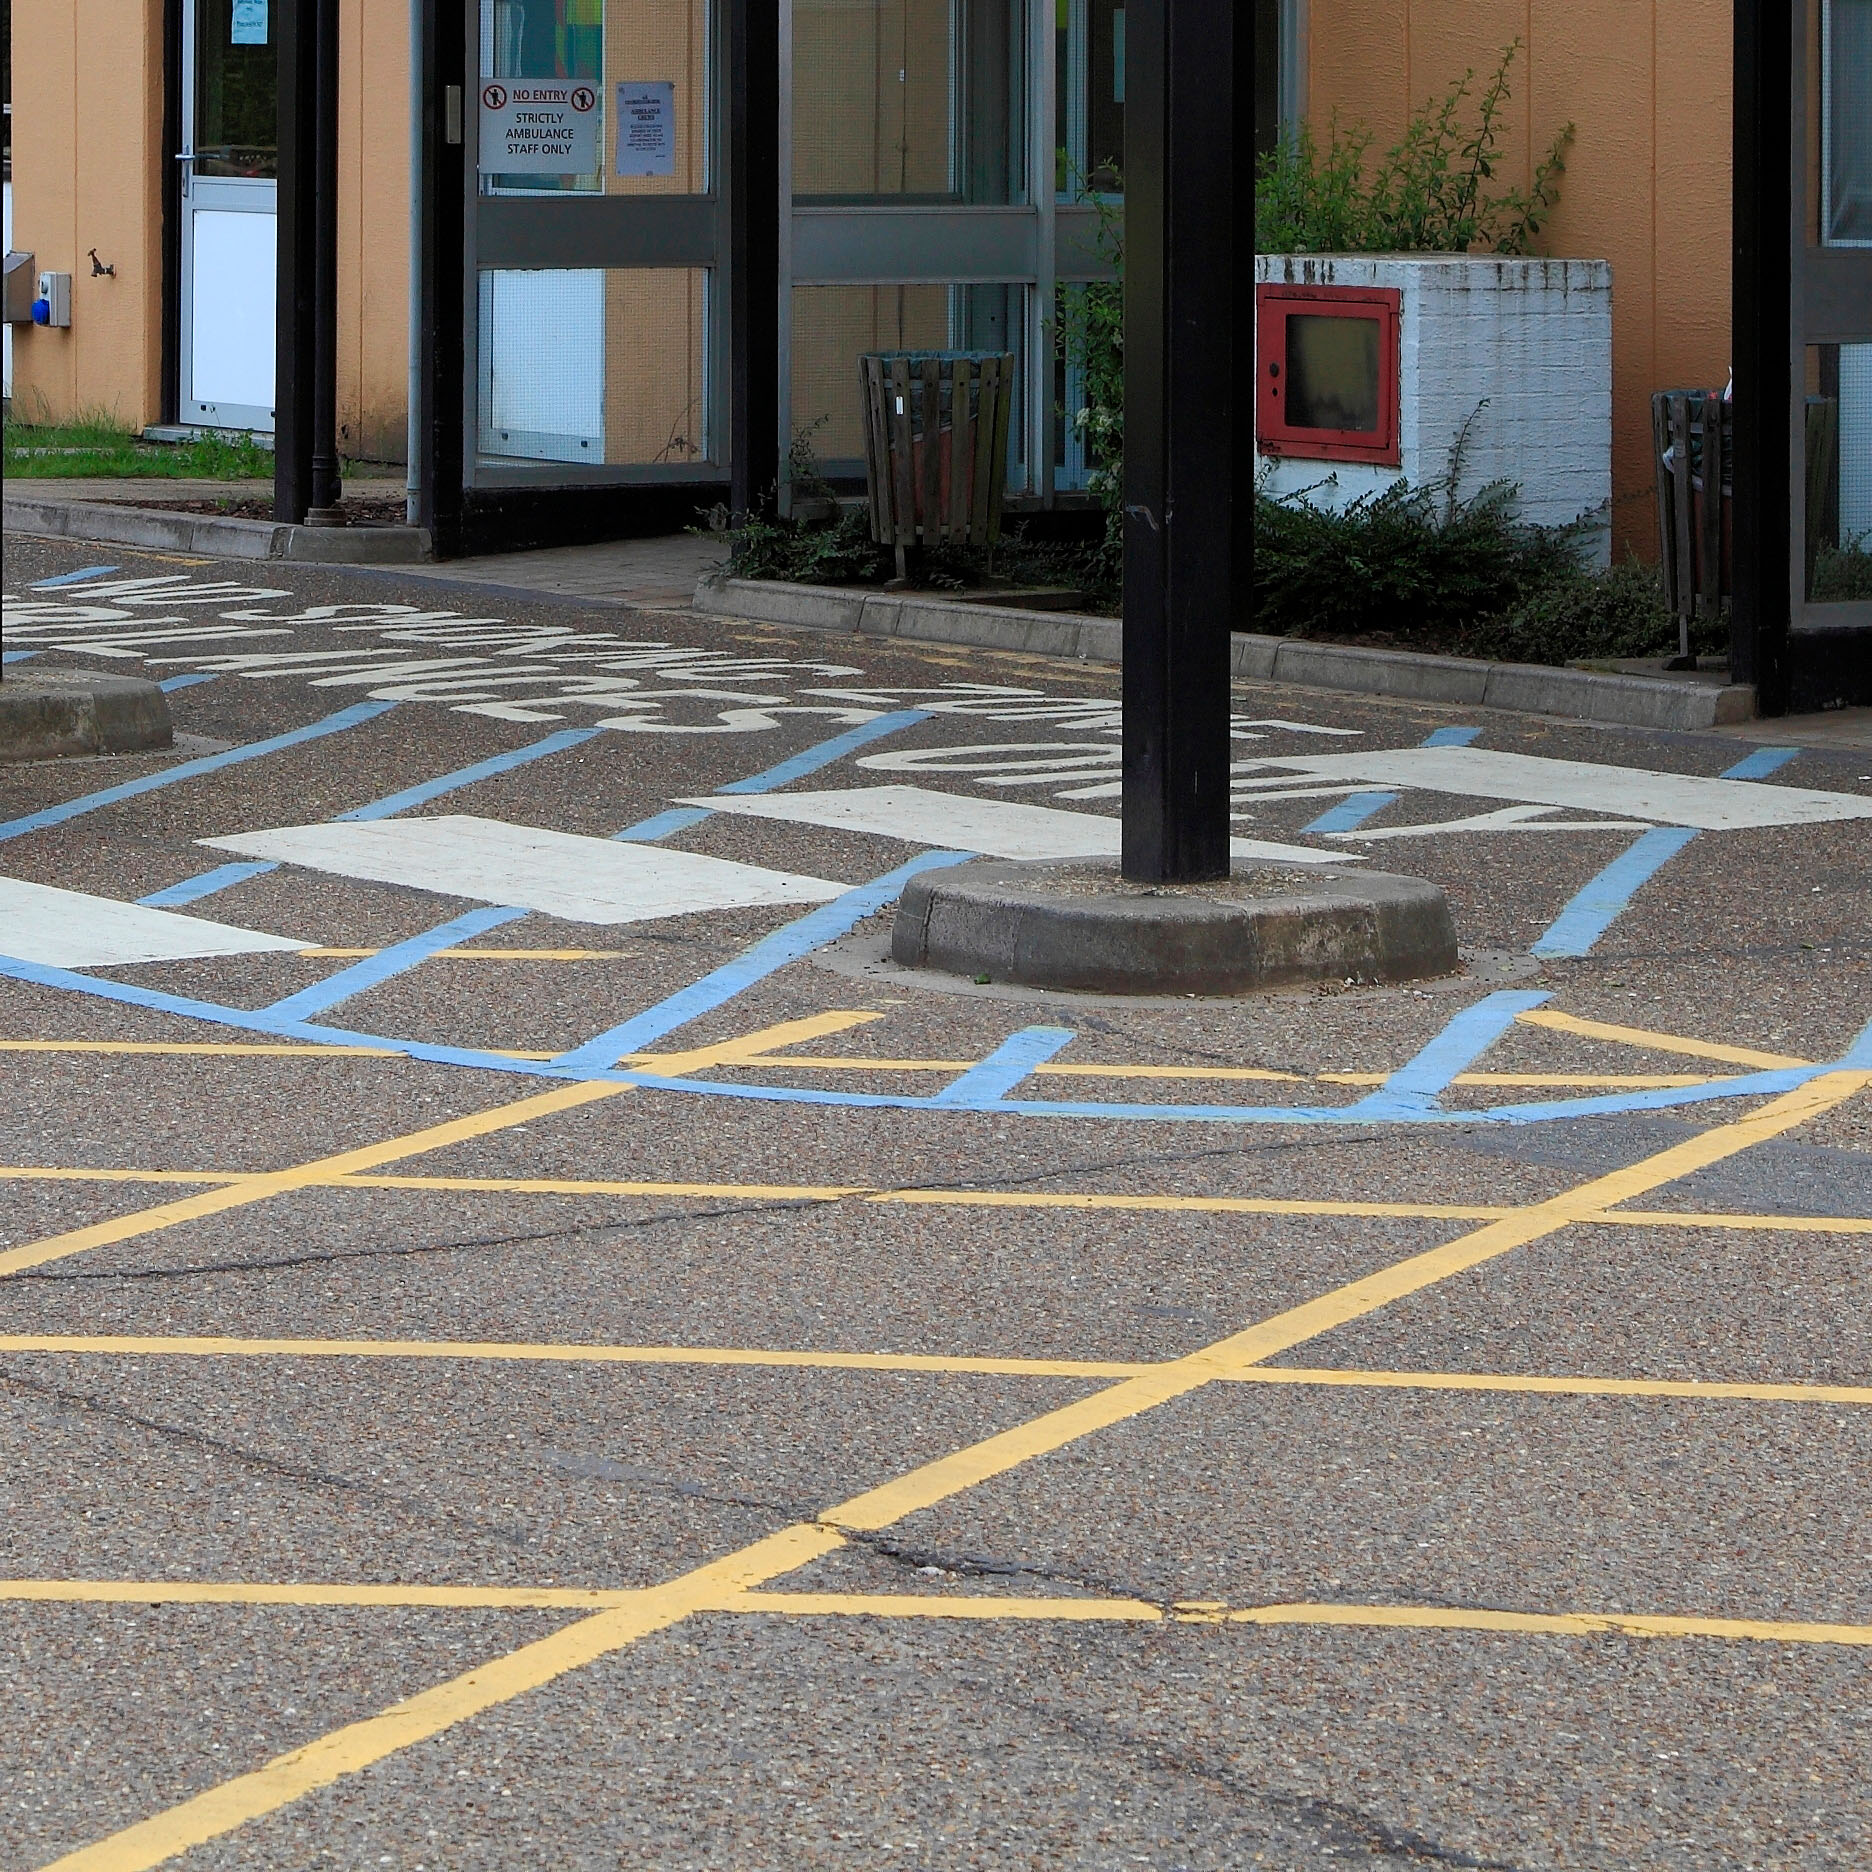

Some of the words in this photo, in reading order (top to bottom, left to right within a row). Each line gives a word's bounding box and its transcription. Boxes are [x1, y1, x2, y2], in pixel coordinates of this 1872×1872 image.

[513, 90, 530, 101] NO
[533, 90, 568, 101] ENTRY
[516, 112, 564, 124] STRICTLY
[505, 128, 574, 139] AMBULANCE
[507, 144, 539, 155] STAFF
[542, 144, 572, 155] ONLY
[29, 575, 294, 605] NO
[219, 604, 865, 681] SMOKING
